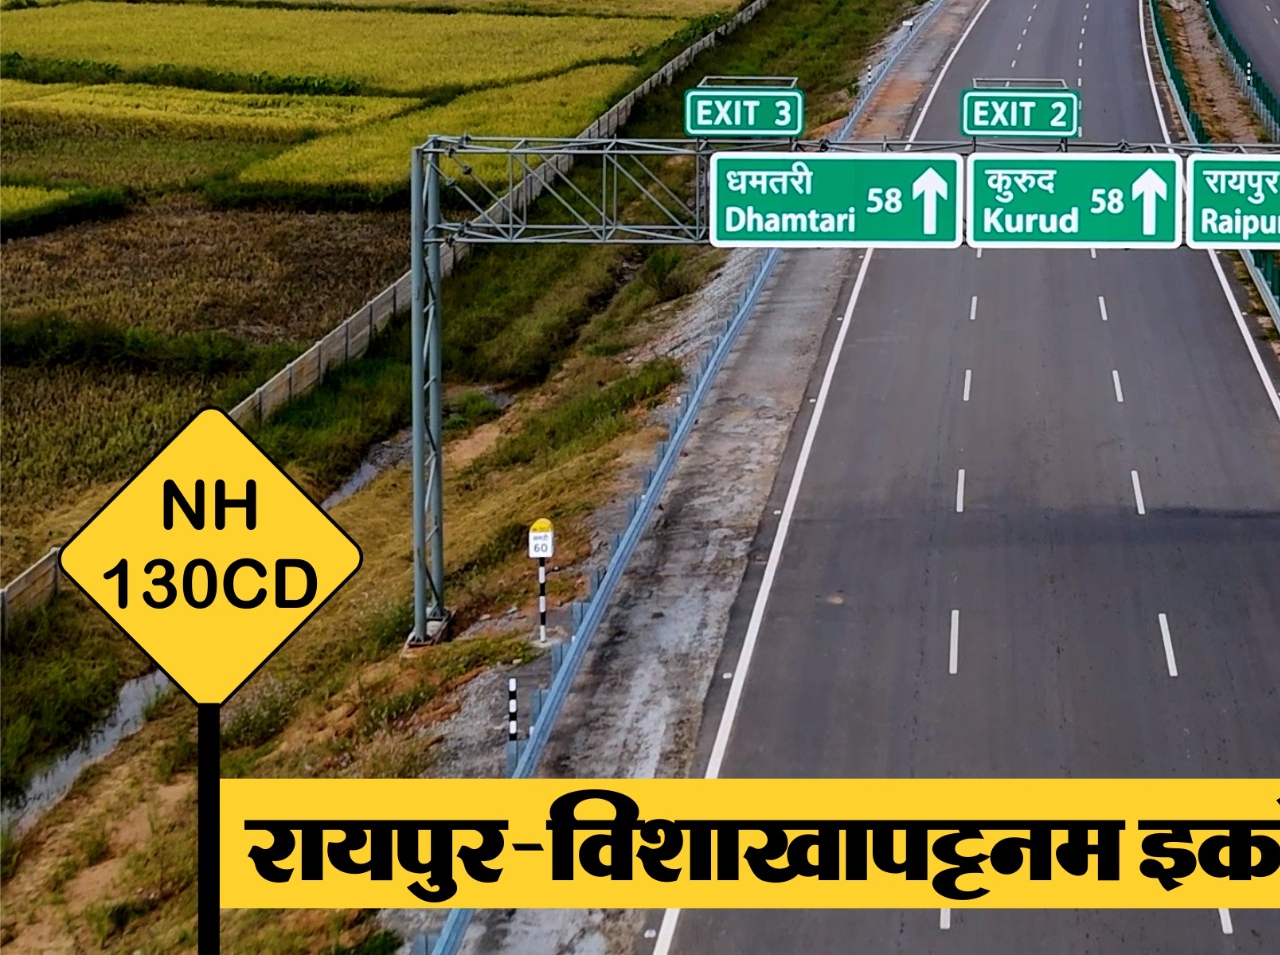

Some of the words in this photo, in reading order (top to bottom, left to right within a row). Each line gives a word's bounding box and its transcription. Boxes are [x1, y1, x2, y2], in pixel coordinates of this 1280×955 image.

[697, 100, 759, 126] EXIT
[774, 100, 791, 126] 3
[972, 101, 1039, 127] EXIT
[1050, 101, 1067, 127] 2
[726, 161, 814, 195] धमतरी
[985, 169, 1057, 203] कुरुद
[1203, 170, 1280, 205] रायपुर
[866, 187, 902, 214] 58
[1090, 188, 1124, 214] 58
[725, 205, 856, 233] Dhamtari
[983, 206, 1079, 234] Kurud
[533, 543, 548, 553] 60
